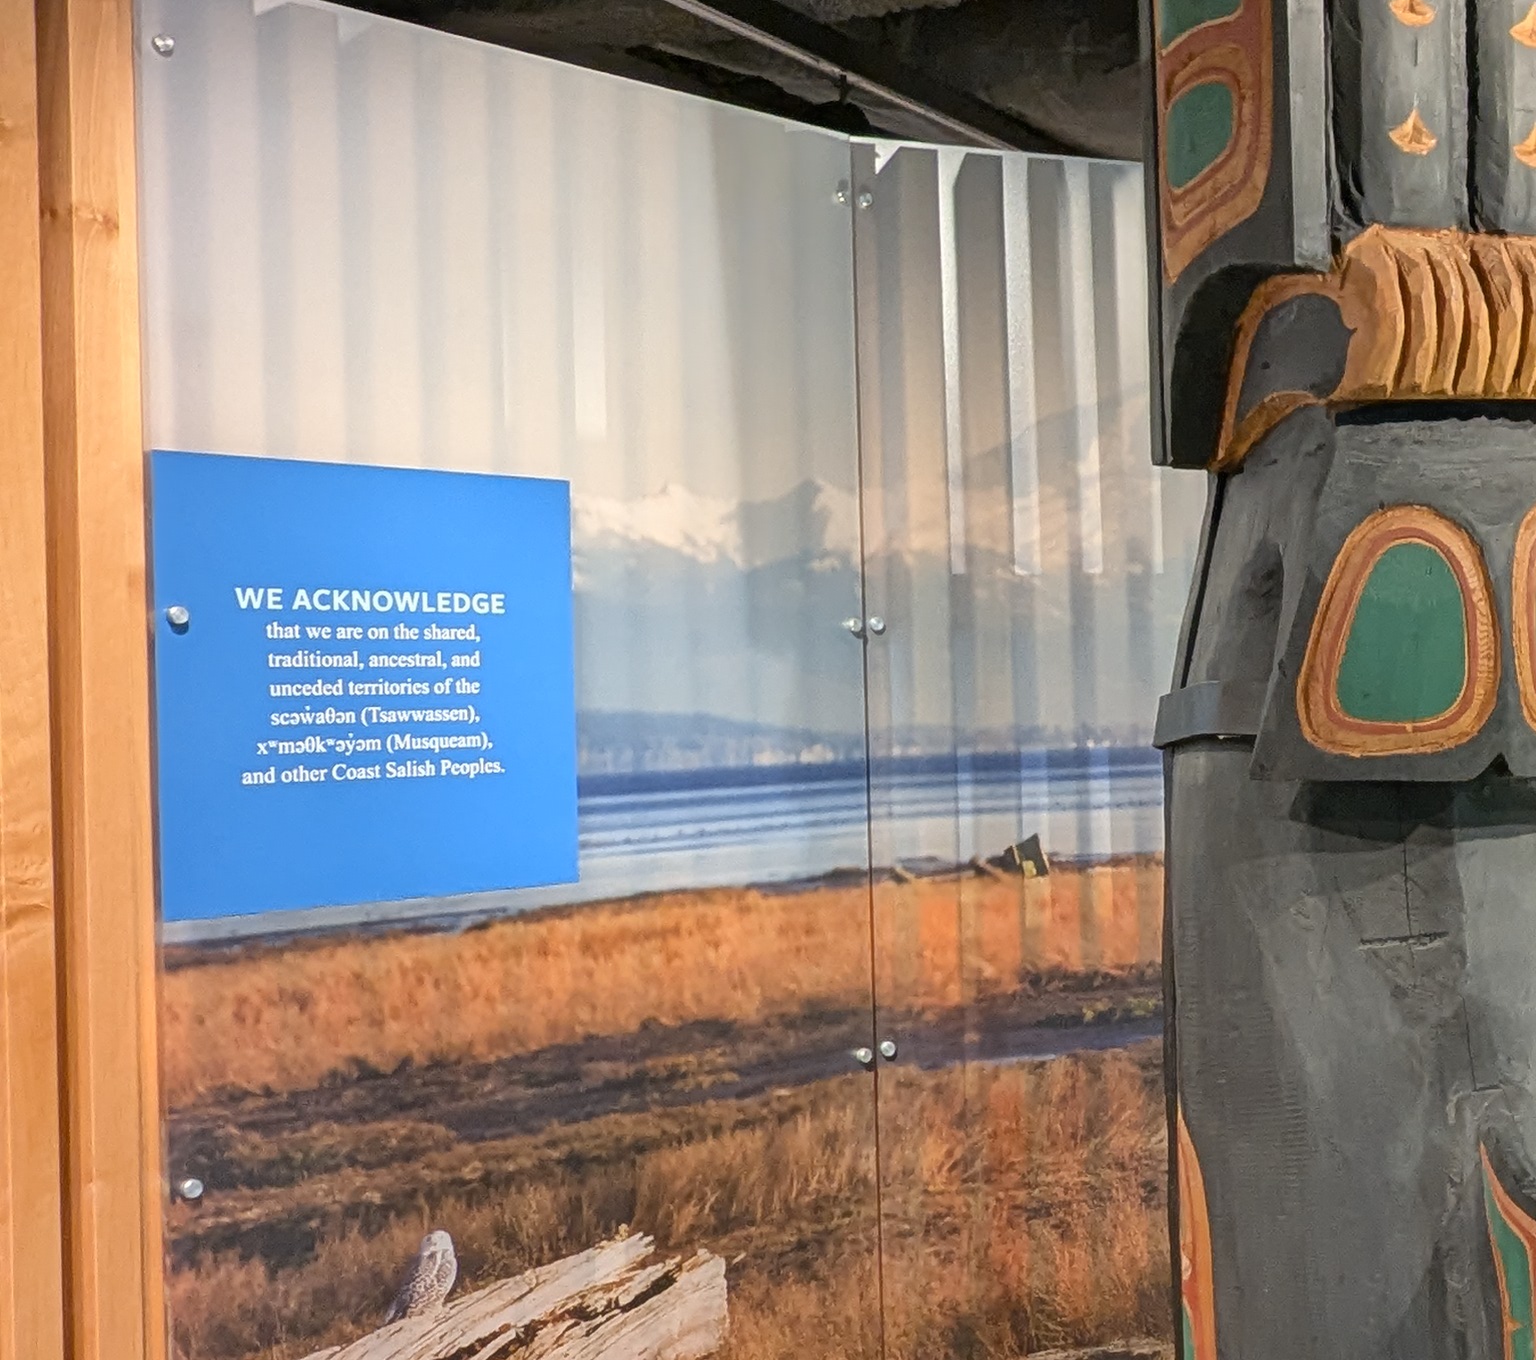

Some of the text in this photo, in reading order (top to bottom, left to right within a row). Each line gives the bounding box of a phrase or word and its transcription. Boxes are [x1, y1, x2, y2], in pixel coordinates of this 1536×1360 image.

[235, 588, 505, 613] WE ACKNOWLEDGE
[266, 622, 480, 642] that we are on the shared,
[268, 651, 480, 669] traditional, ancestral, and
[270, 678, 480, 696] unceded territories of the
[361, 705, 480, 726] (Tsawwassen),
[387, 732, 492, 753] (Musqueam),
[242, 758, 505, 784] and other Coast Salish Peoples.
